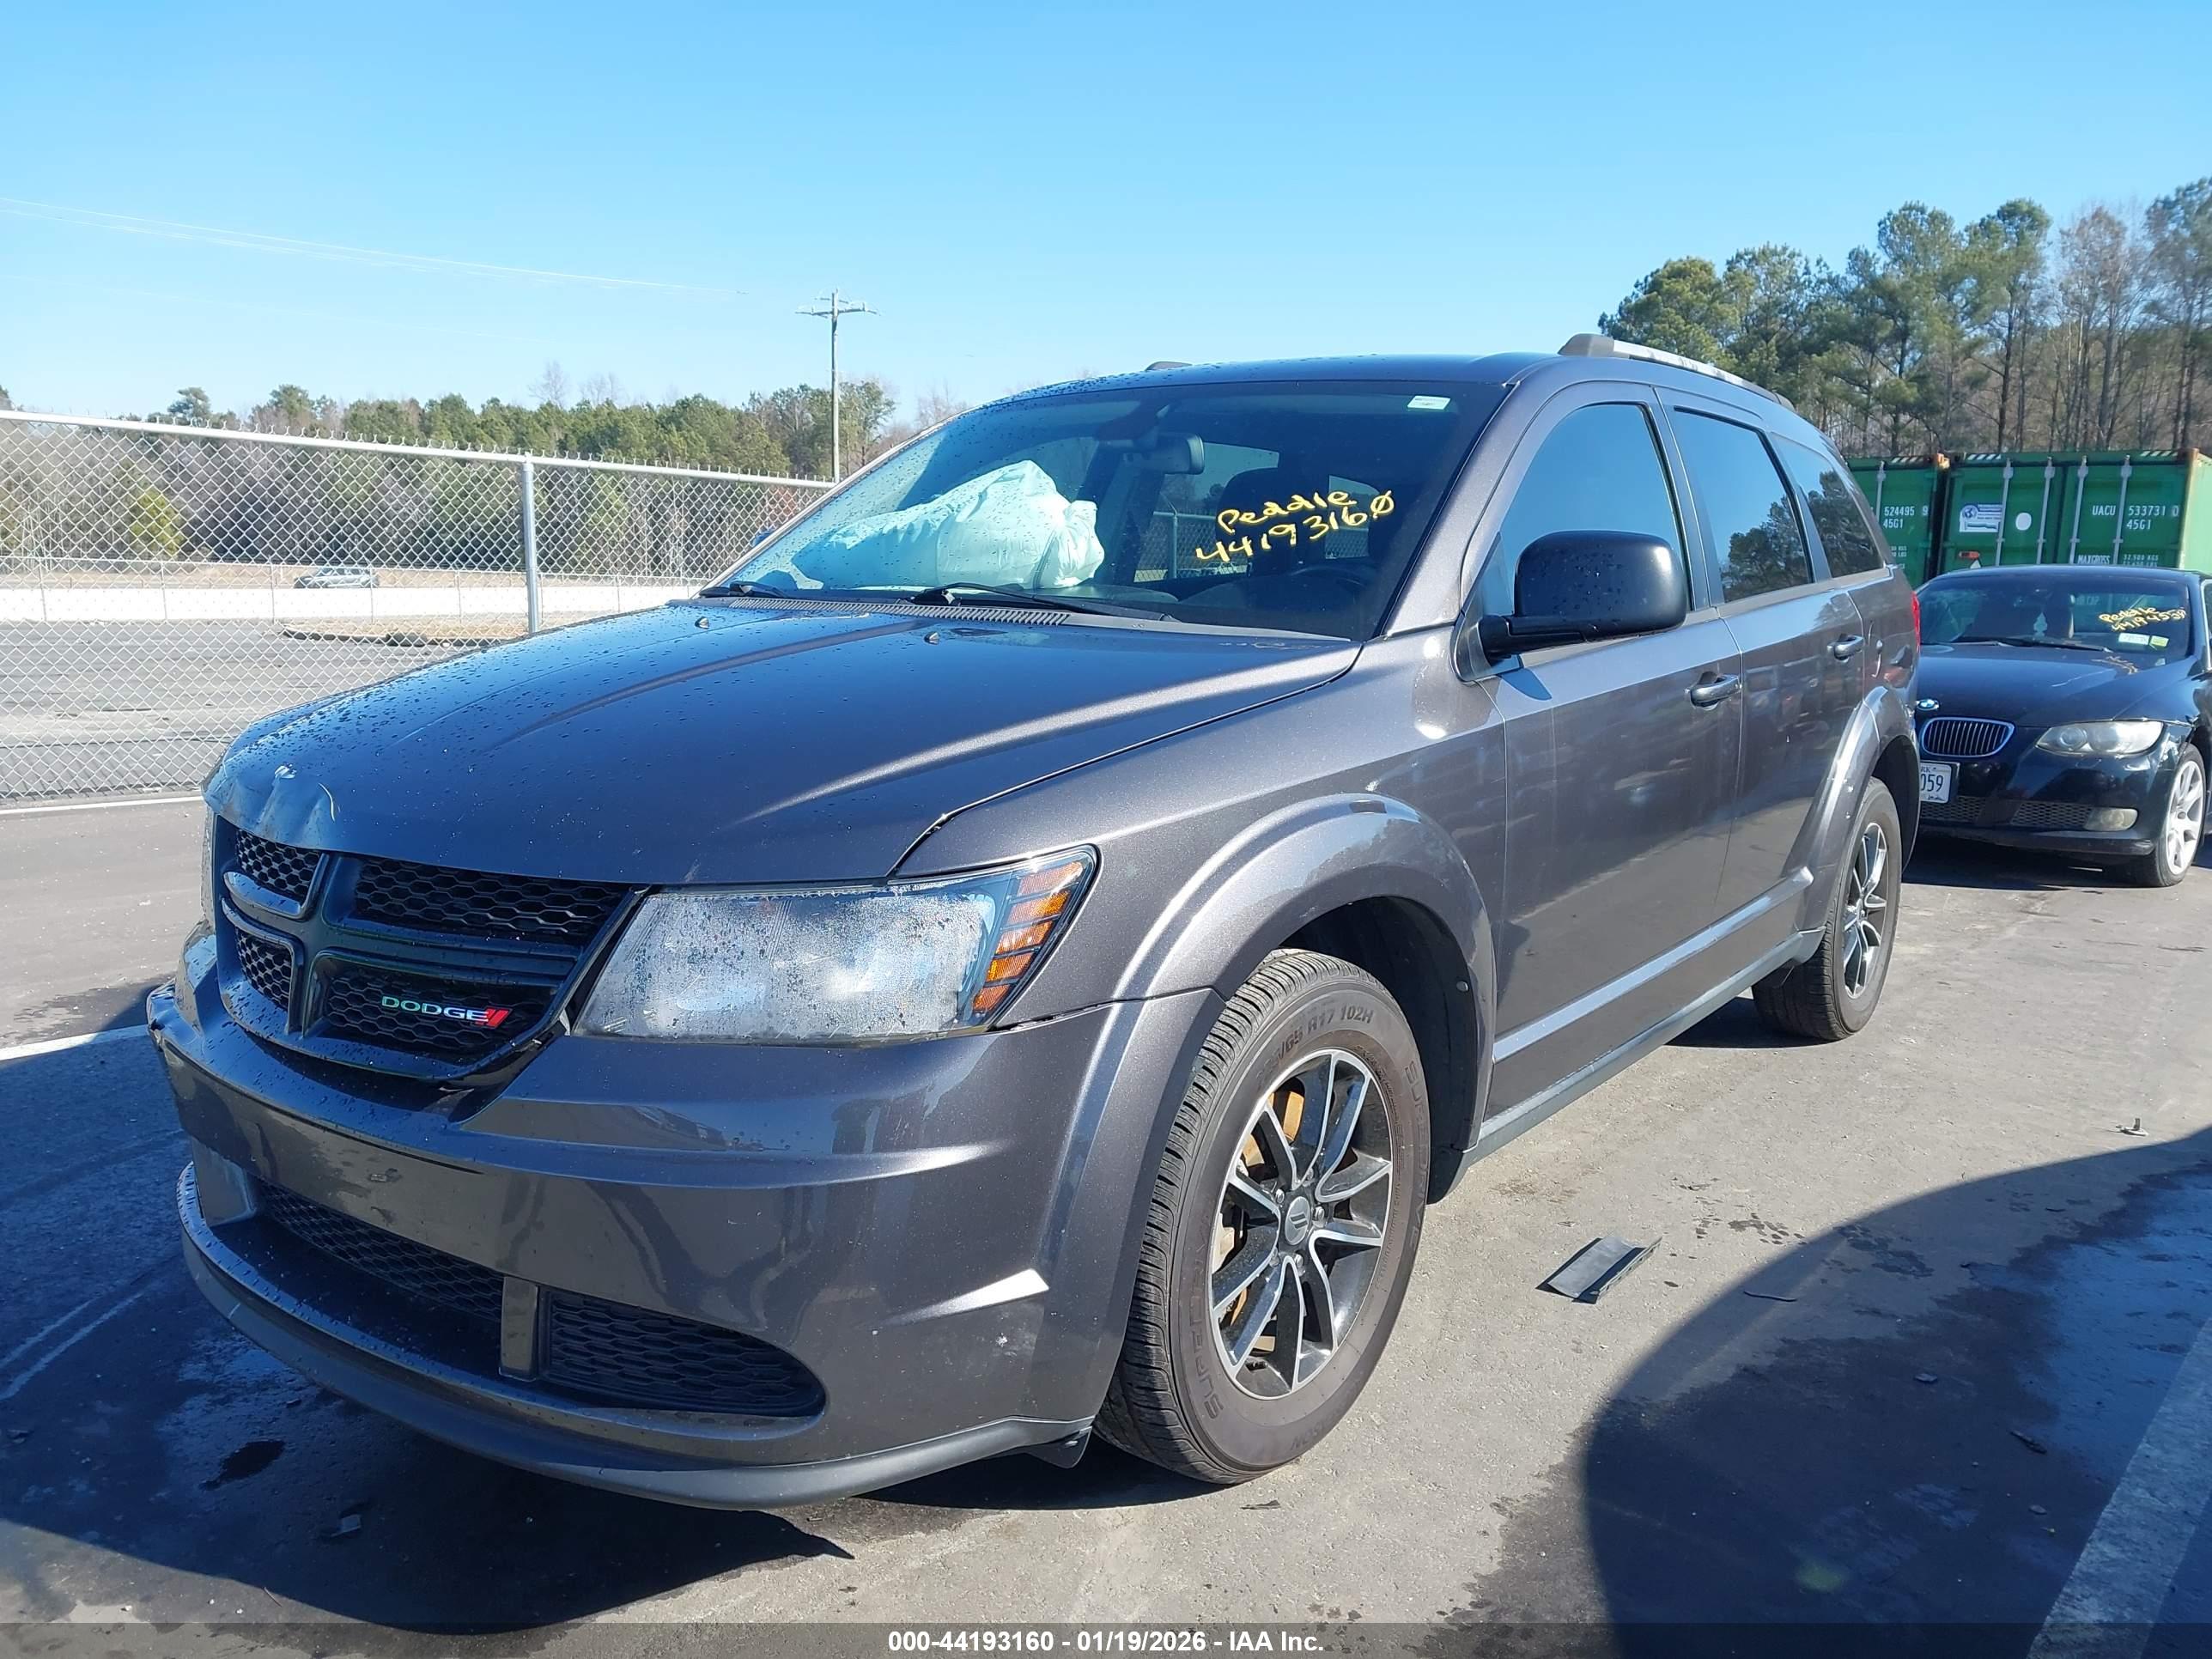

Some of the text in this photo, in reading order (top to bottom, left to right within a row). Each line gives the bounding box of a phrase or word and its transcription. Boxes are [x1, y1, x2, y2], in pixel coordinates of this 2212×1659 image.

[1217, 491, 1358, 534] Peddle
[1884, 506, 1915, 516] 524495
[2092, 505, 2117, 516] UACU
[2128, 505, 2166, 516] 533731
[1883, 519, 1904, 529] 45G1
[2126, 520, 2151, 530] 45G1
[381, 995, 489, 1023] DODGE
[1340, 1003, 1375, 1024] 102H
